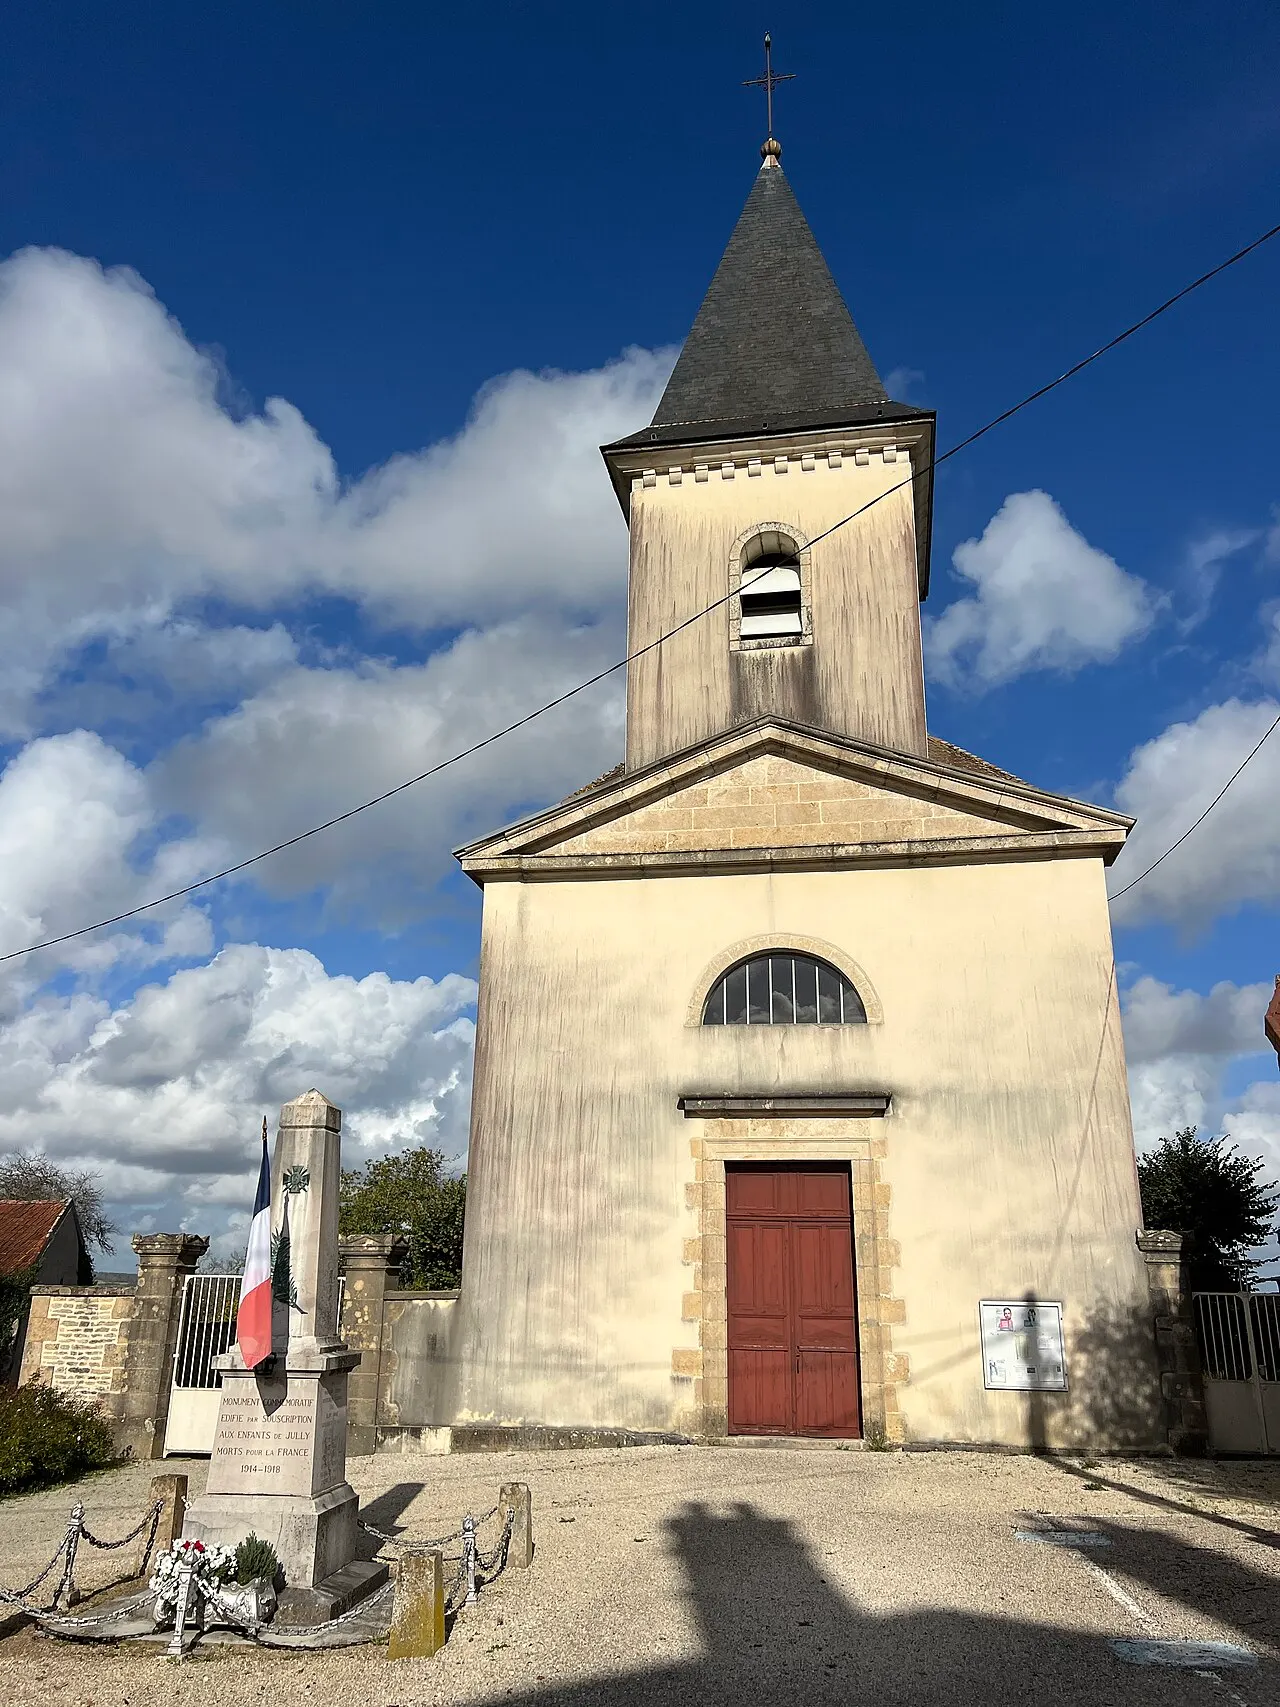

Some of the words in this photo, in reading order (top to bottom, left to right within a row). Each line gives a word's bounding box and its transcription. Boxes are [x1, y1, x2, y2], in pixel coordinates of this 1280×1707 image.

[222, 1398, 260, 1406] MONUMENT
[262, 1414, 313, 1424] SOUSCRIPTION
[219, 1431, 235, 1439] AUX
[237, 1431, 271, 1439] ENFANTS
[285, 1431, 311, 1440] JULLY
[216, 1447, 243, 1456] MORTS
[277, 1448, 309, 1457] FRANCE
